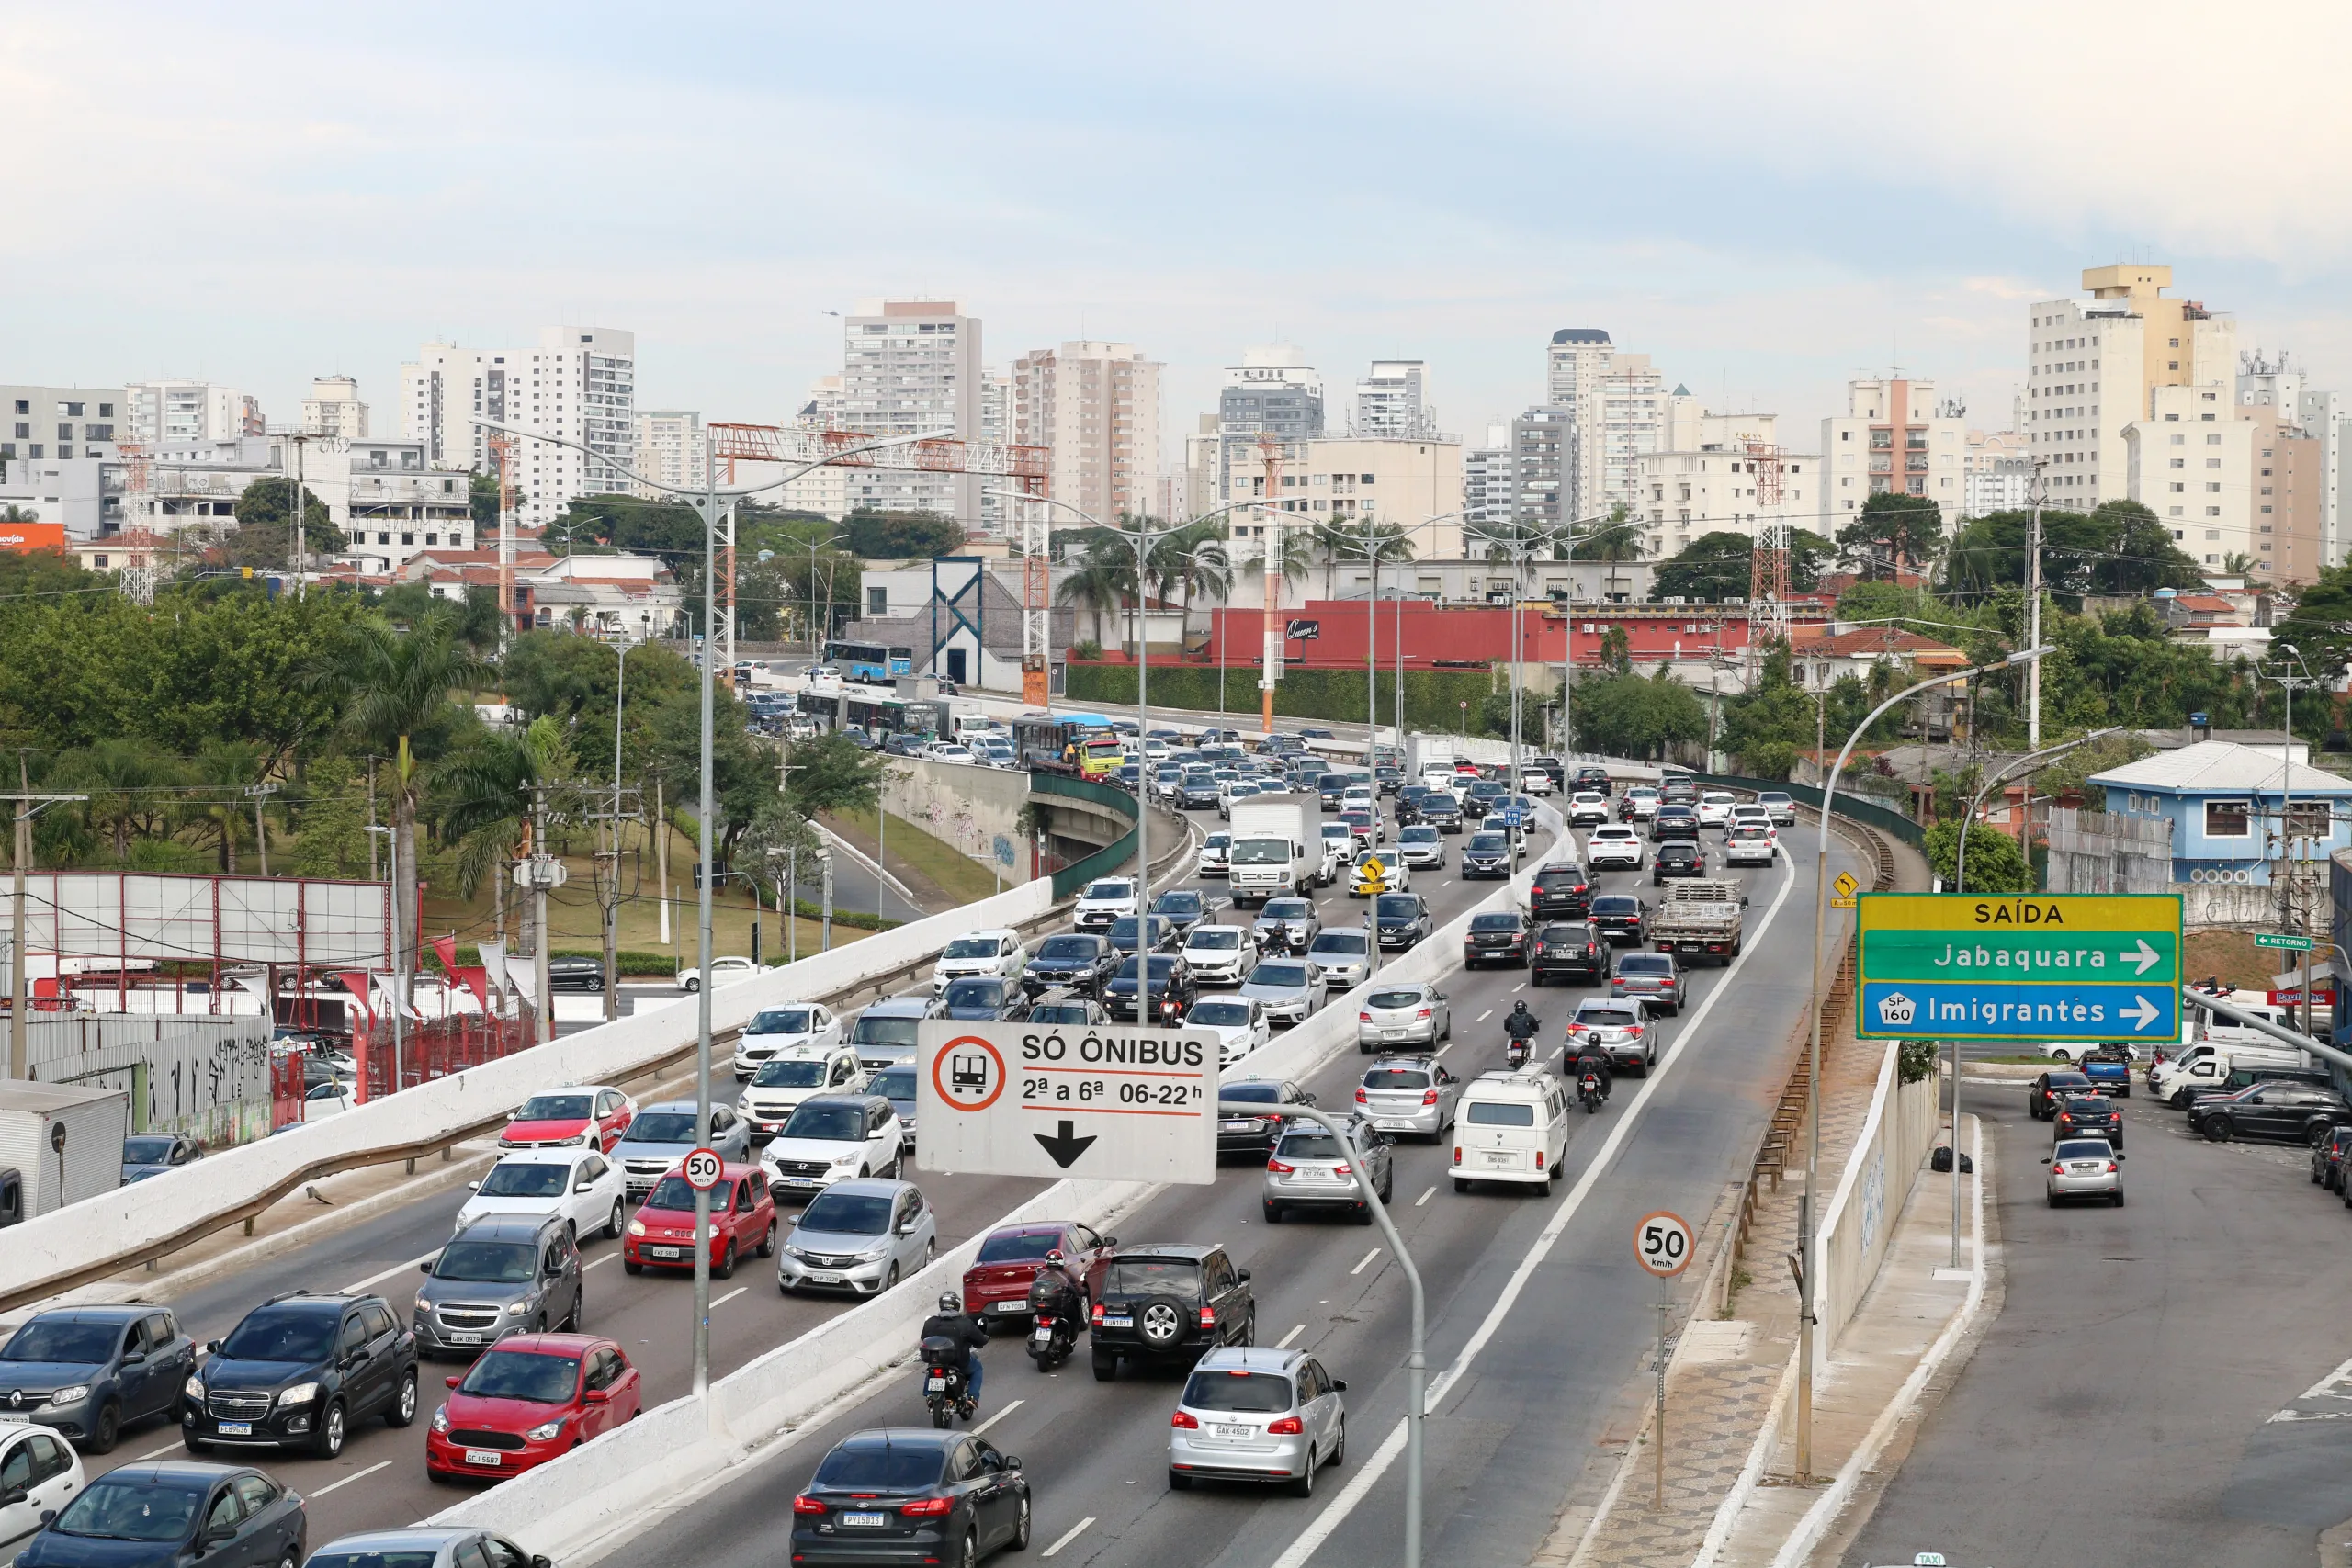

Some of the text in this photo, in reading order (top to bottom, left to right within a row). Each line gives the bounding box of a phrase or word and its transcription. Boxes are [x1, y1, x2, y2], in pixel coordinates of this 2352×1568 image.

[1287, 619, 1317, 639] Queen's
[1974, 898, 2064, 924] SAÍDA
[2270, 938, 2307, 947] RETORNO
[1934, 944, 2106, 972] Jabaquara
[1888, 997, 1905, 1007] SP
[2277, 993, 2325, 1001] Pauliho
[1883, 1009, 1910, 1021] 160
[1929, 997, 2105, 1025] Imigrantes
[1022, 1028, 1203, 1066] SÓ ÔNIBUS
[1057, 1086, 1070, 1100] a
[689, 1157, 717, 1176] 50
[1644, 1225, 1685, 1258] 50
[1651, 1258, 1673, 1269] km/h
[467, 1454, 481, 1462] GCJ
[1919, 1554, 1941, 1564] TAXI
